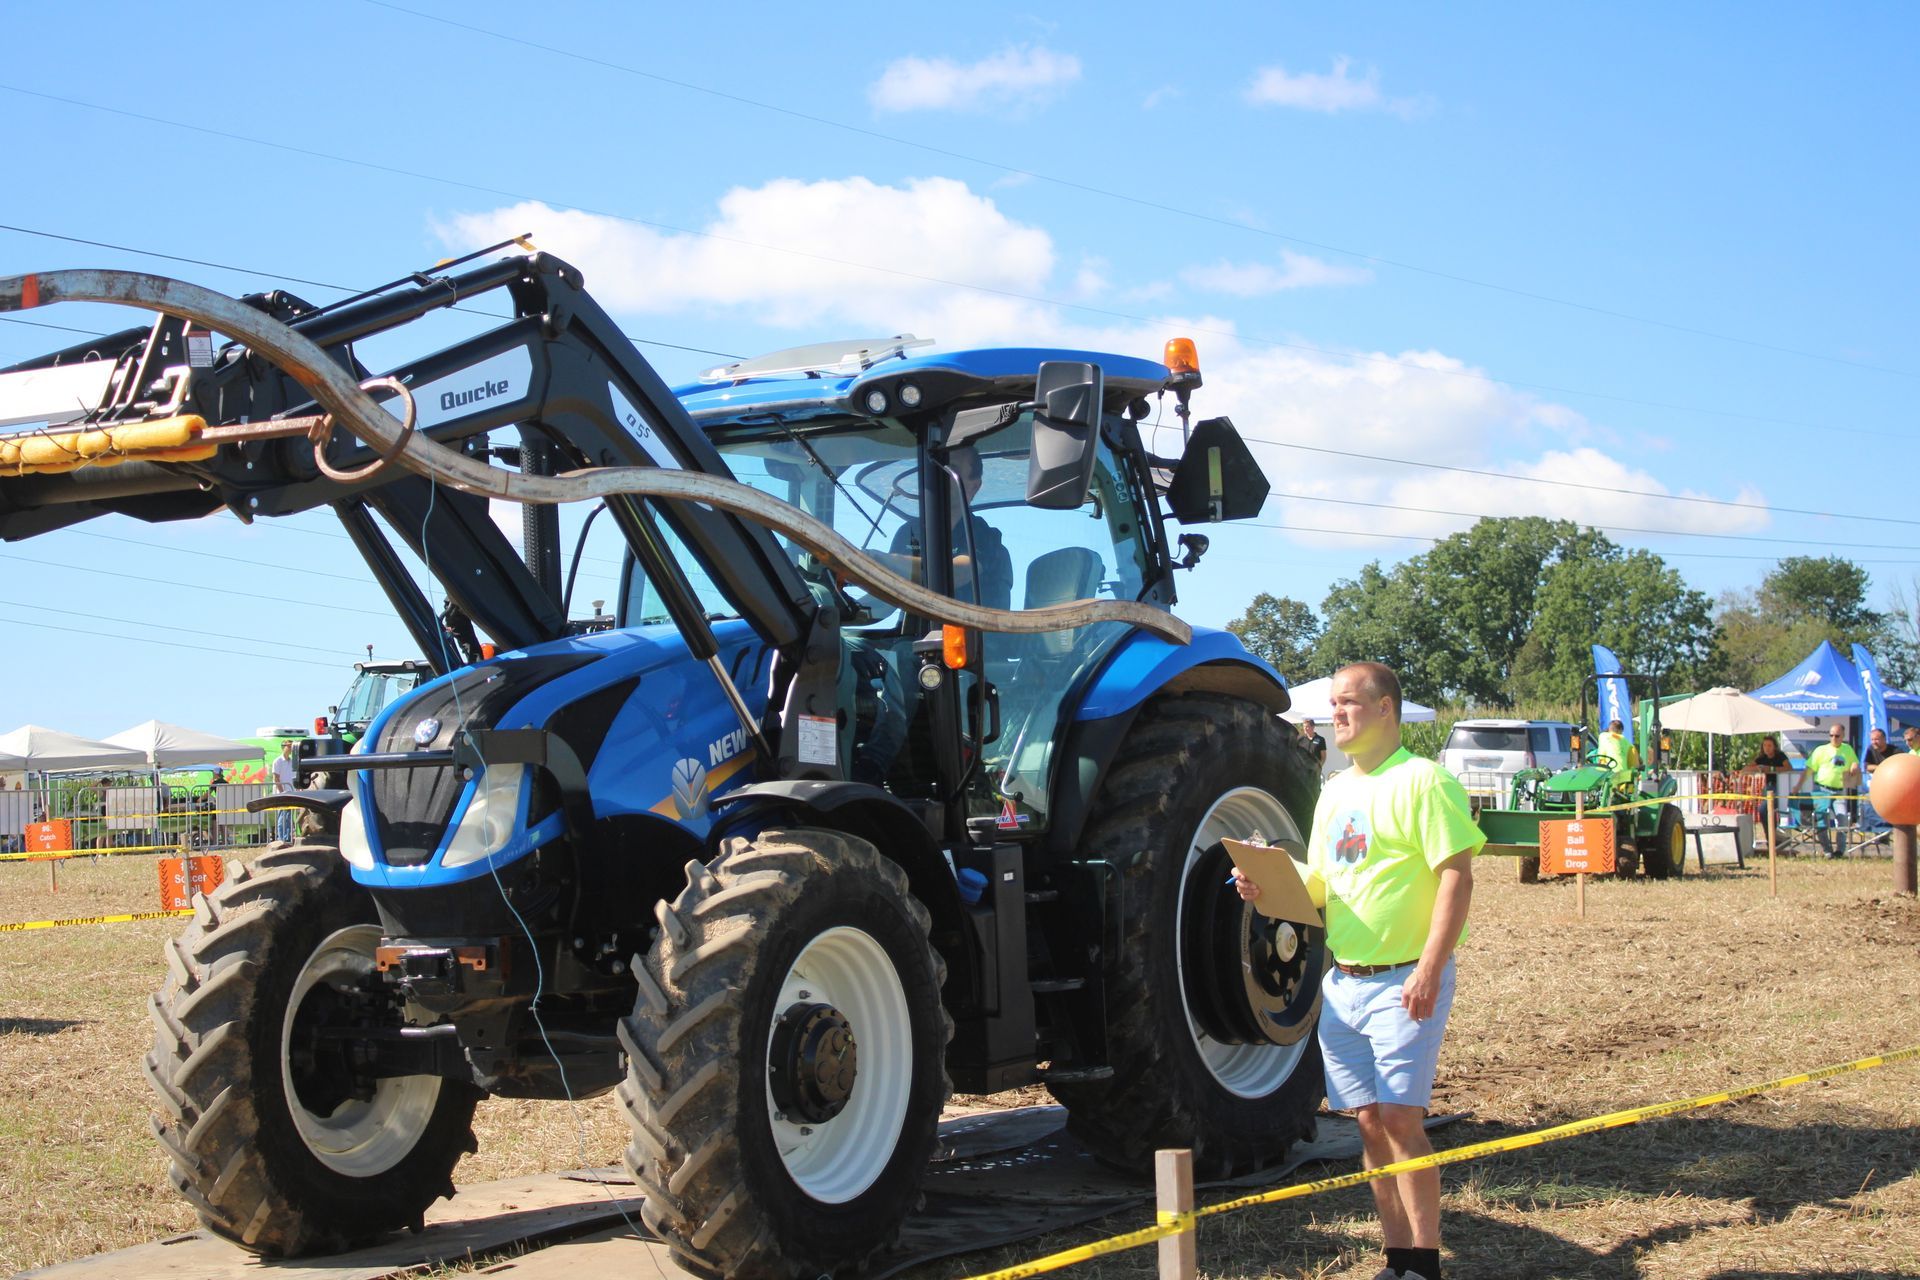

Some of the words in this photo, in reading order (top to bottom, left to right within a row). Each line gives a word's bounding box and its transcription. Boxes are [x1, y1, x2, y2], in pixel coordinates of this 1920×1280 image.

[440, 380, 509, 411] Quicke
[1773, 702, 1838, 712] maxspan.ca
[708, 727, 749, 766] NEW
[1567, 822, 1583, 832] #8:
[1567, 836, 1585, 844] Ball
[1564, 848, 1588, 856] Maze
[1565, 859, 1588, 869] Drop
